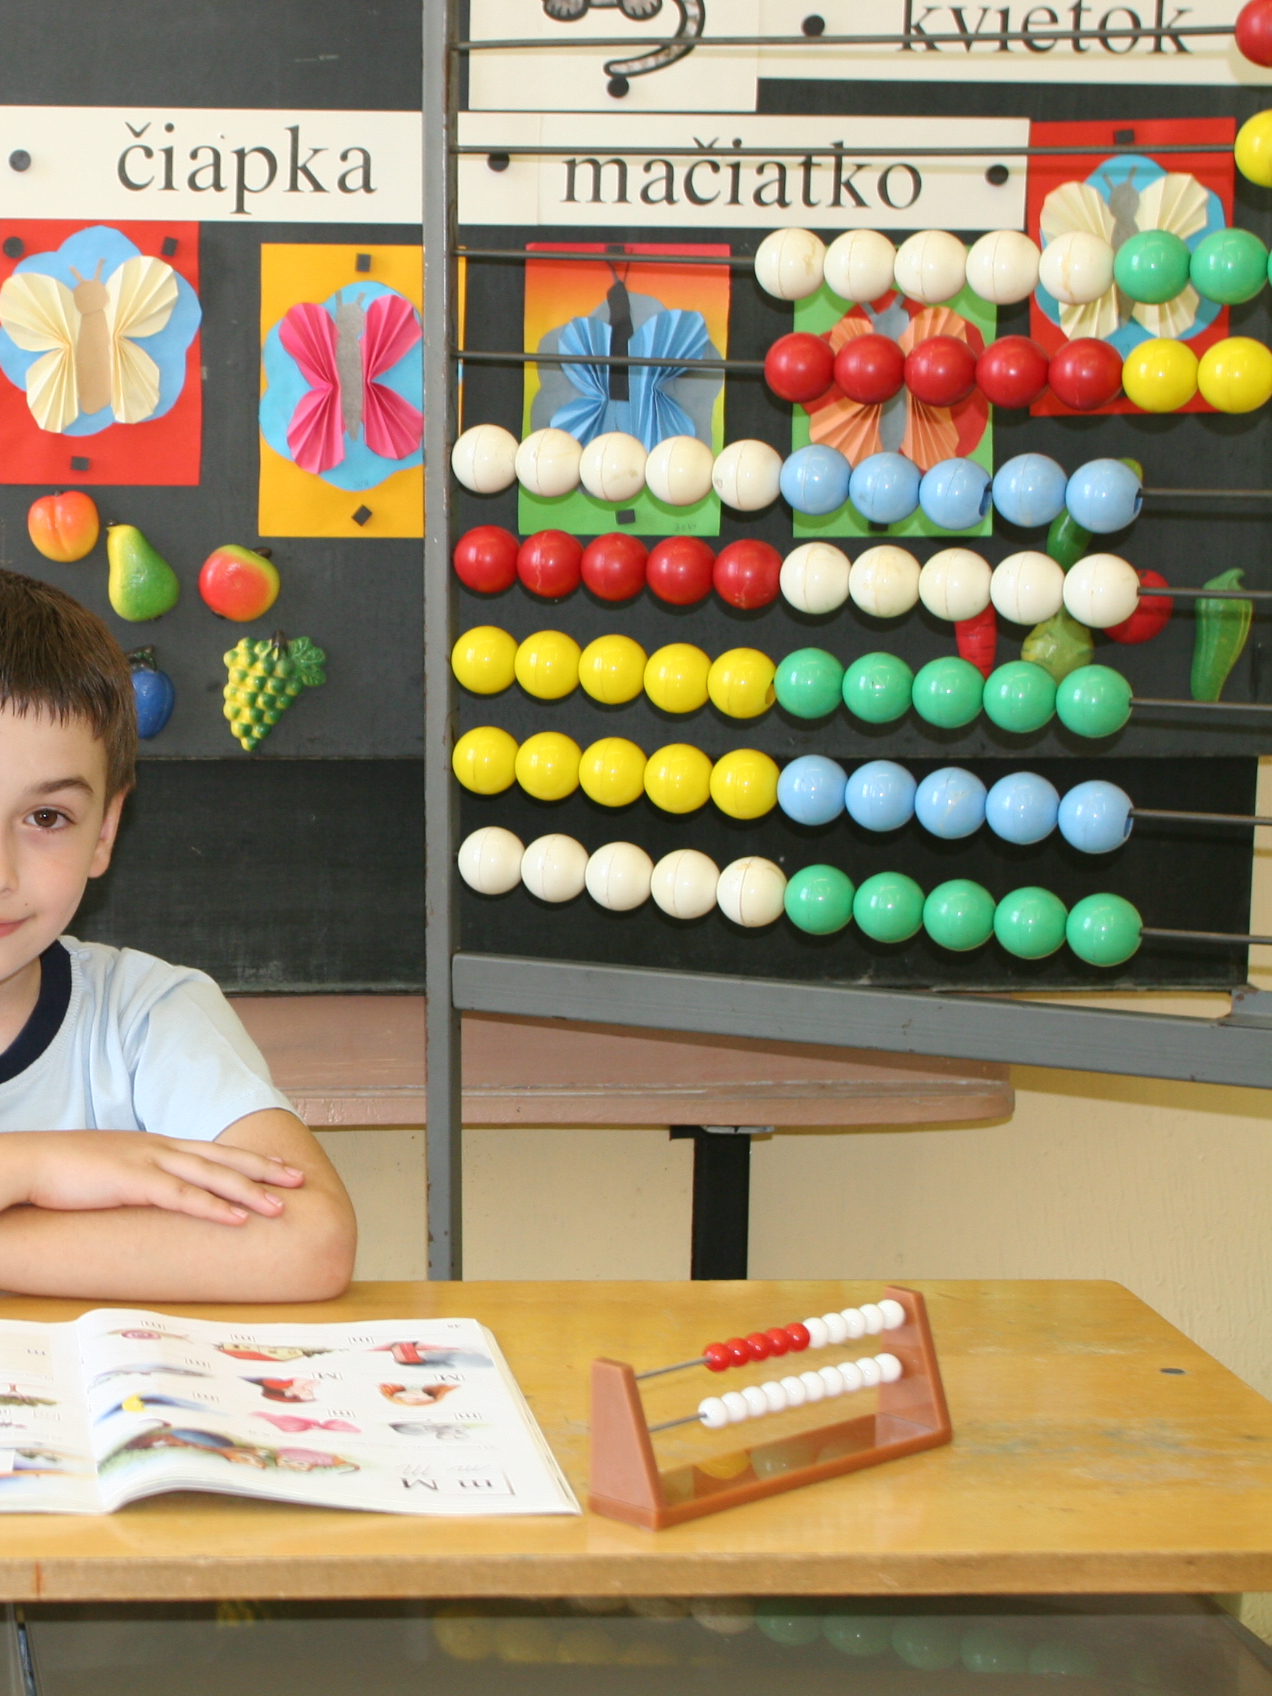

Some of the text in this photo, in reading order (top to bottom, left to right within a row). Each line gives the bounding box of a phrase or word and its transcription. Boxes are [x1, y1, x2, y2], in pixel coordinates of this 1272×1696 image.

[896, 0, 1195, 54] kvietok
[117, 121, 378, 215] čiapka
[559, 136, 922, 209] mačiatko
